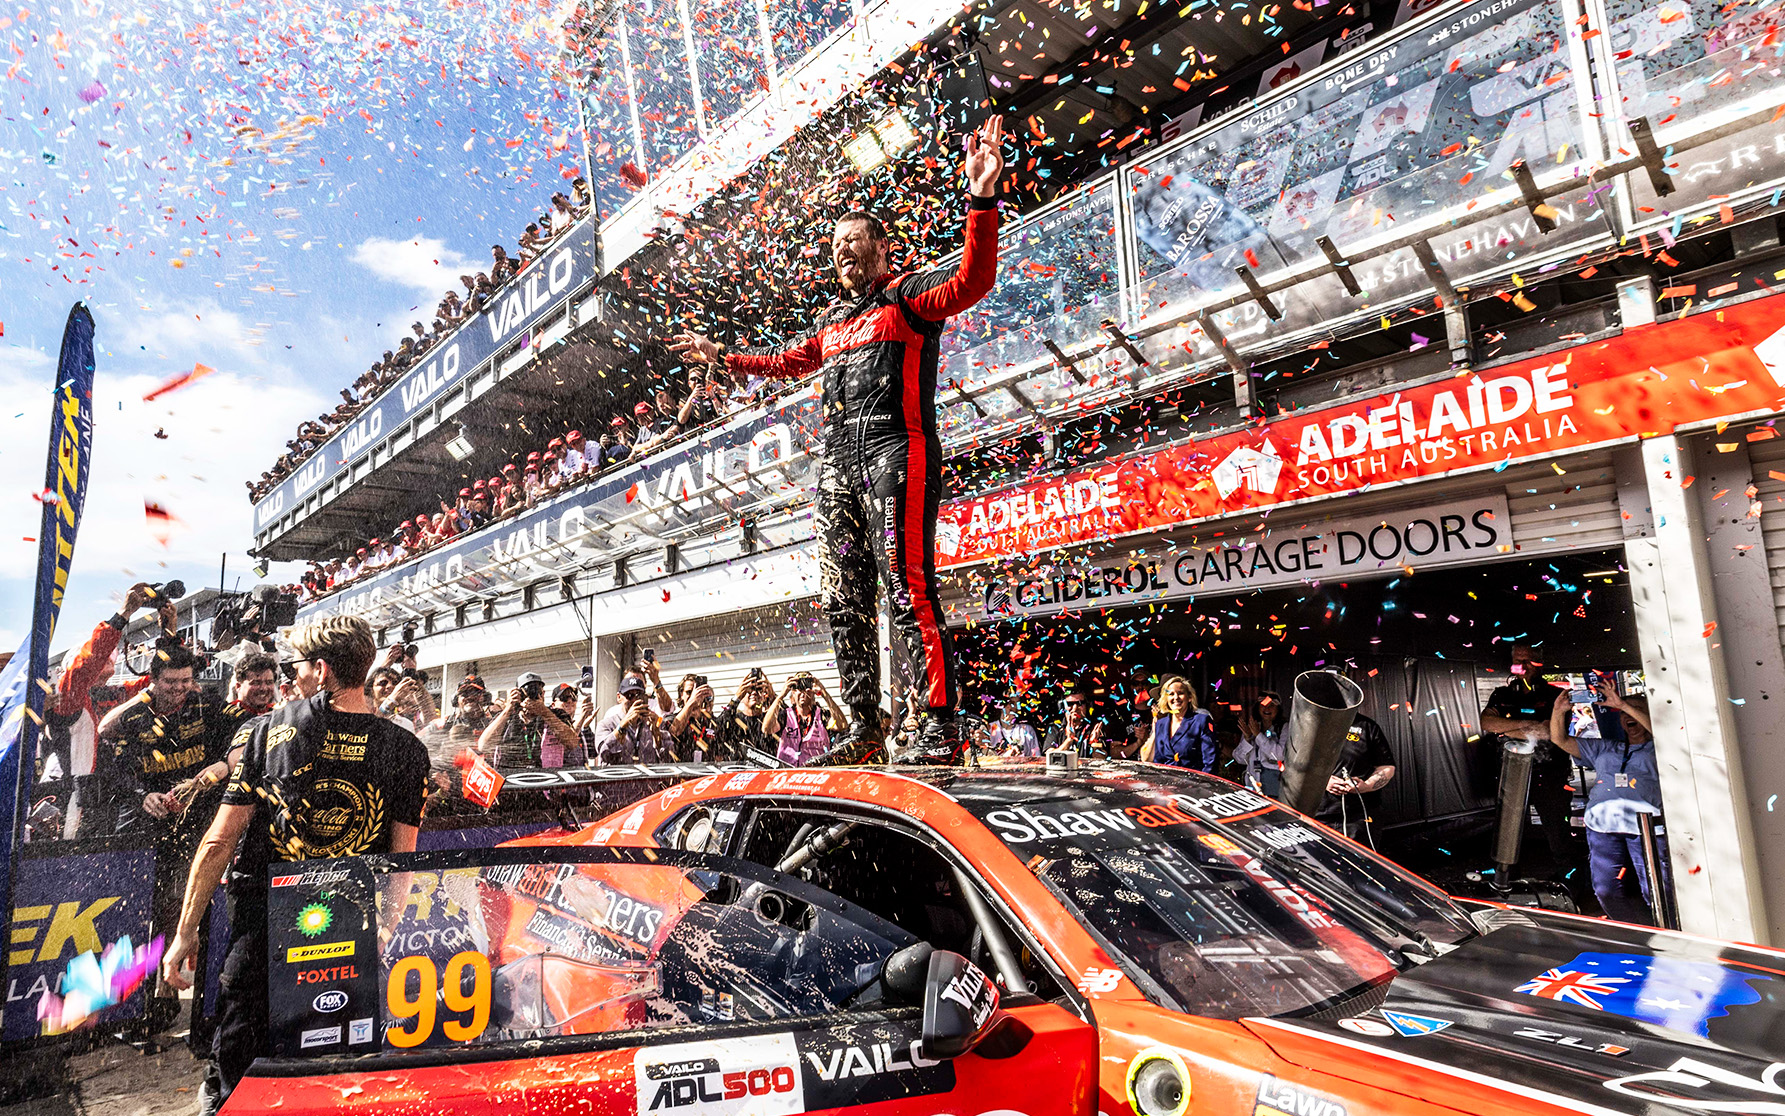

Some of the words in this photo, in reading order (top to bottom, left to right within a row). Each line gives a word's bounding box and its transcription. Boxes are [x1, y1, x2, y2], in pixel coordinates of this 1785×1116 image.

[1325, 65, 1364, 91] BONE
[1369, 47, 1398, 69] DRY
[1241, 97, 1298, 133] SCHILD
[1148, 141, 1217, 180] RESCHKE
[1056, 194, 1113, 227] STONEHAVEN
[1159, 197, 1184, 230] SCHILD
[1166, 195, 1220, 262] BAROSSA
[488, 247, 573, 343] VAILO
[401, 343, 460, 413] VAILO
[341, 407, 382, 459] VAILO
[1297, 366, 1575, 467] ADELAIDE
[1298, 452, 1390, 491] SOUTH
[1400, 413, 1578, 467] AUSTRALIA
[293, 455, 326, 499] VAILO
[637, 423, 791, 526] VAILO
[258, 490, 284, 528] VAILO
[969, 473, 1122, 536] ADELAIDE
[492, 504, 585, 579] VAILO
[1026, 511, 1123, 543] AUSTRALIA
[1015, 559, 1169, 610] GLIDEROL
[1173, 537, 1324, 587] GARAGE
[1336, 508, 1498, 566] DOORS
[469, 768, 492, 793] grays
[506, 762, 752, 788] erebus
[787, 771, 831, 785] strata
[299, 944, 351, 958] DUNLOP
[297, 965, 359, 985] FOXTEL
[319, 993, 341, 1005] FOX
[386, 949, 493, 1049] 99
[659, 1062, 705, 1076] VAILO
